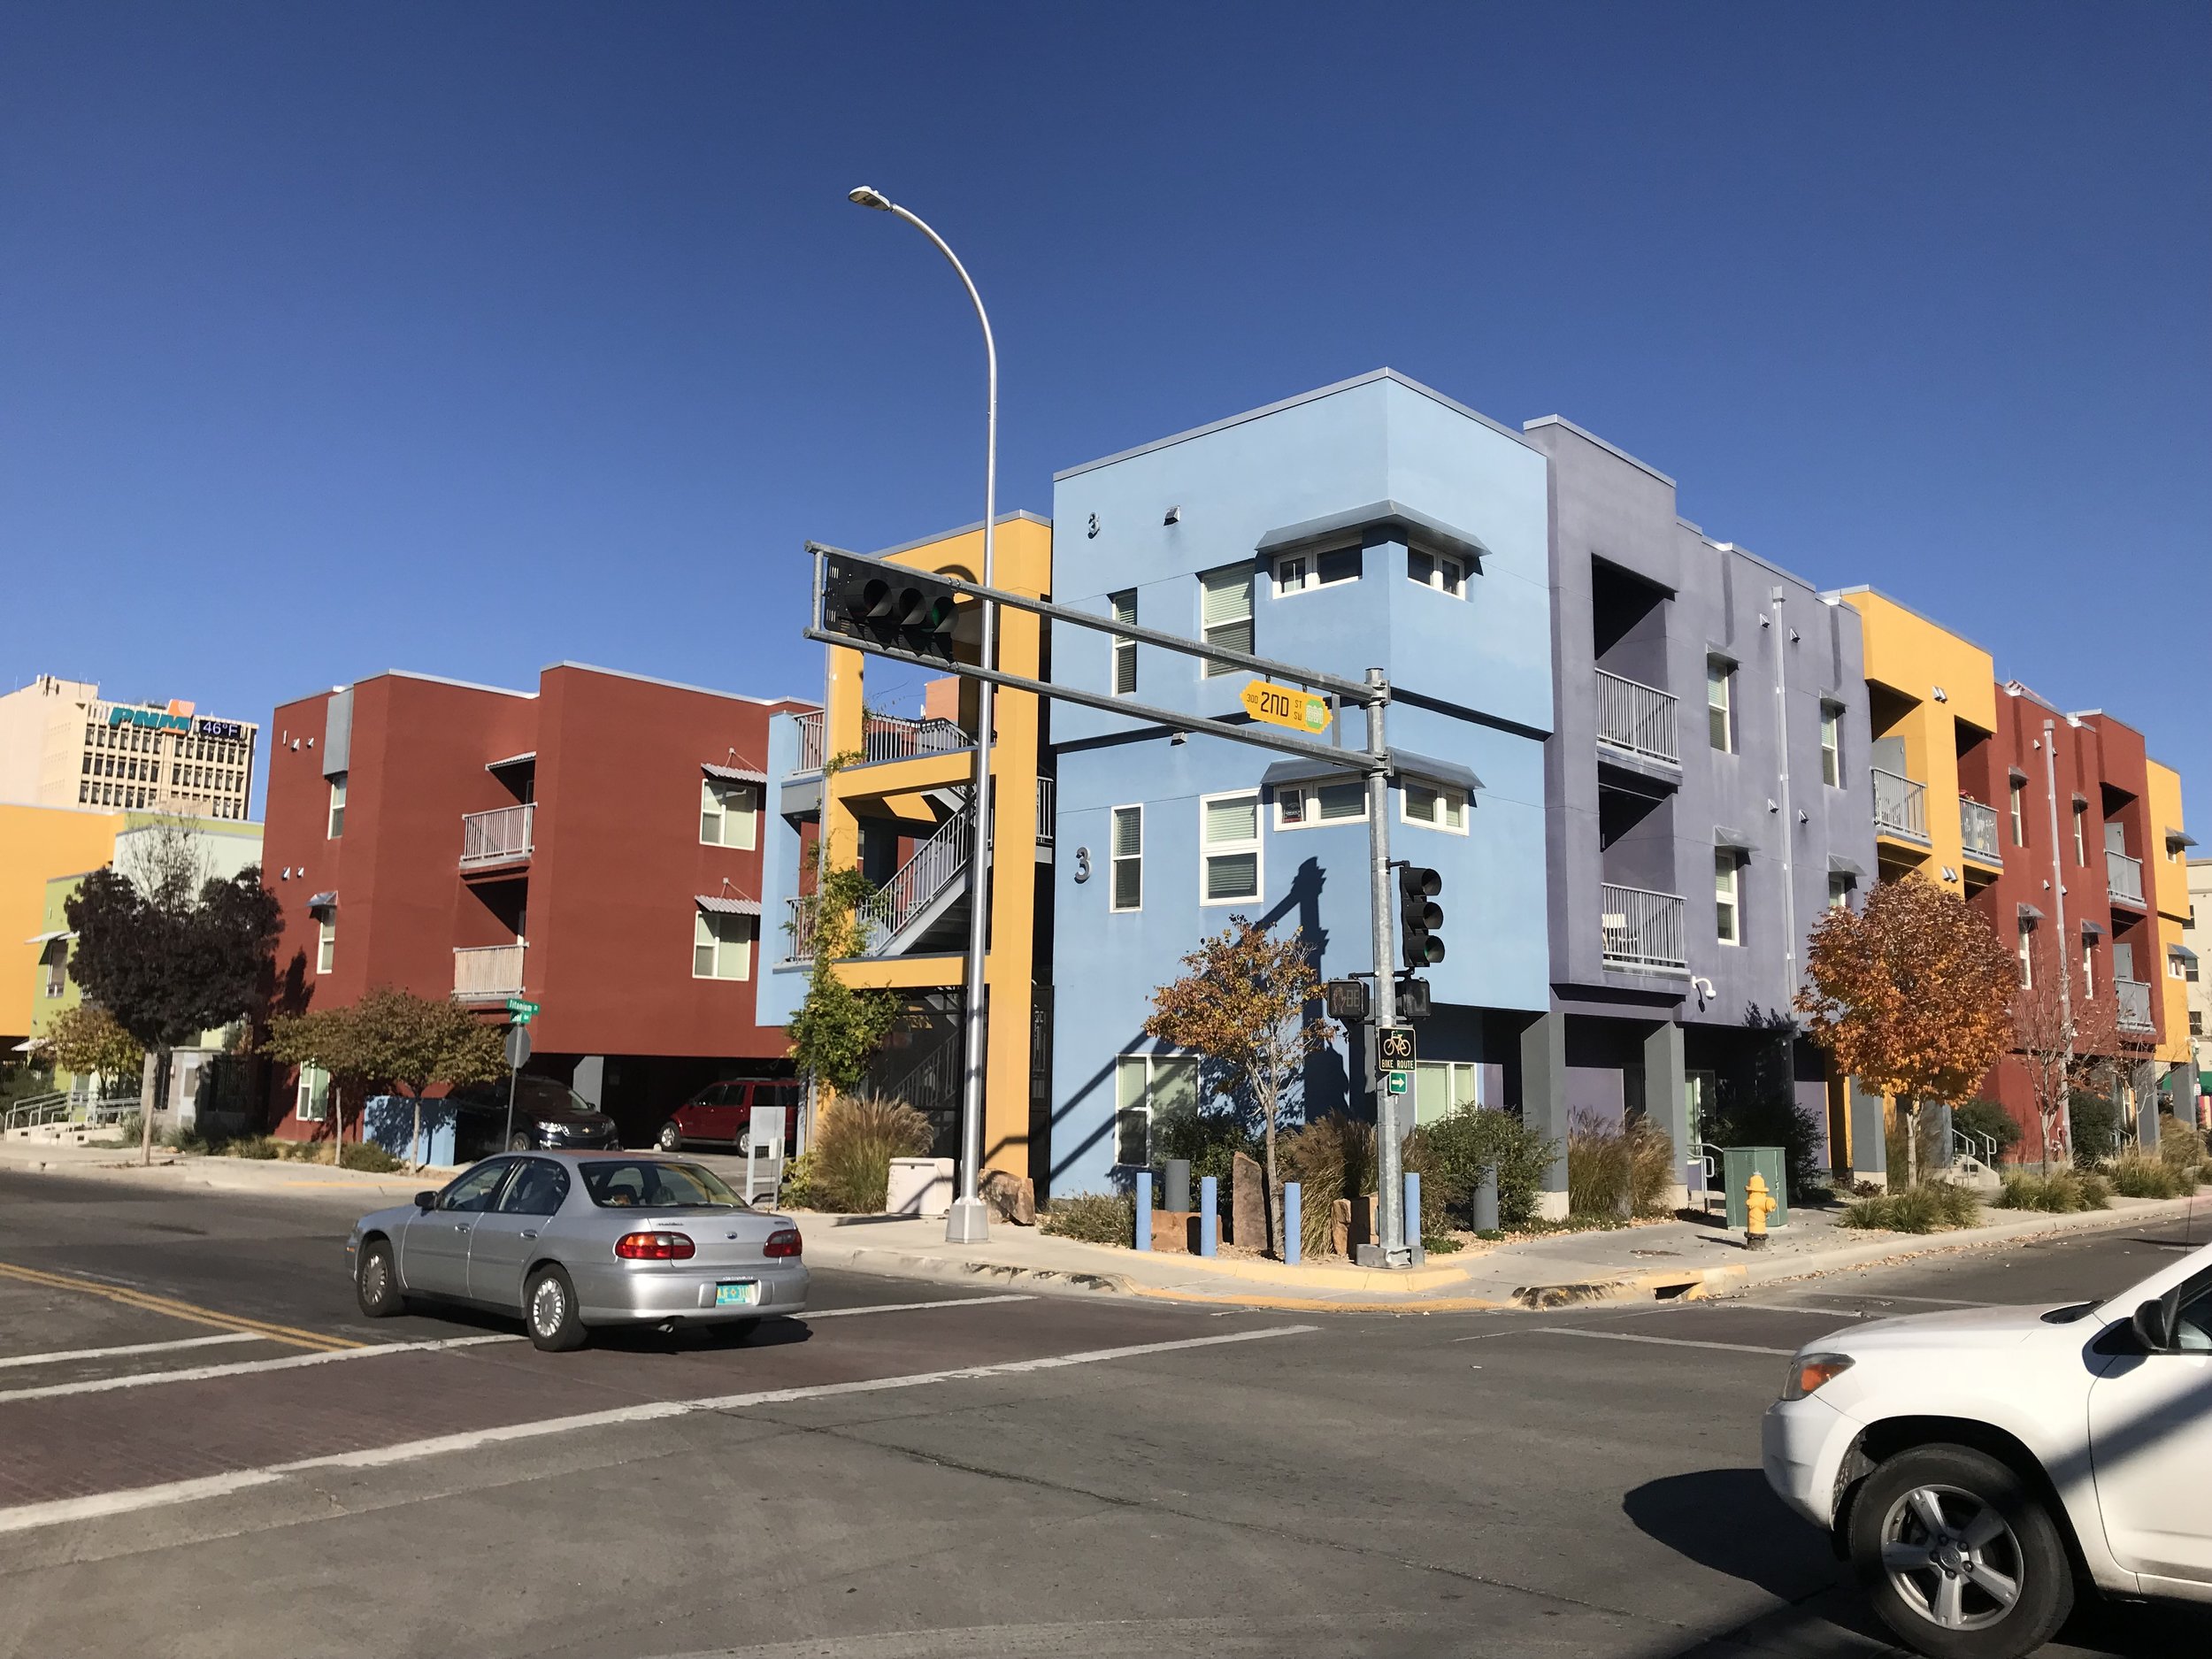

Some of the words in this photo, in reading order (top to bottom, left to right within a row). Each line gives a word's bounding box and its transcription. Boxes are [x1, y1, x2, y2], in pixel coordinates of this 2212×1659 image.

[1088, 511, 1101, 539] 3
[1260, 691, 1289, 718] 2ND
[1294, 699, 1302, 709] ST
[108, 707, 191, 730] PNM
[1294, 711, 1302, 721] SW
[203, 721, 238, 736] 46°F
[1074, 846, 1091, 882] 3
[1381, 1059, 1394, 1068] BIKE
[1396, 1059, 1414, 1069] ROUTE
